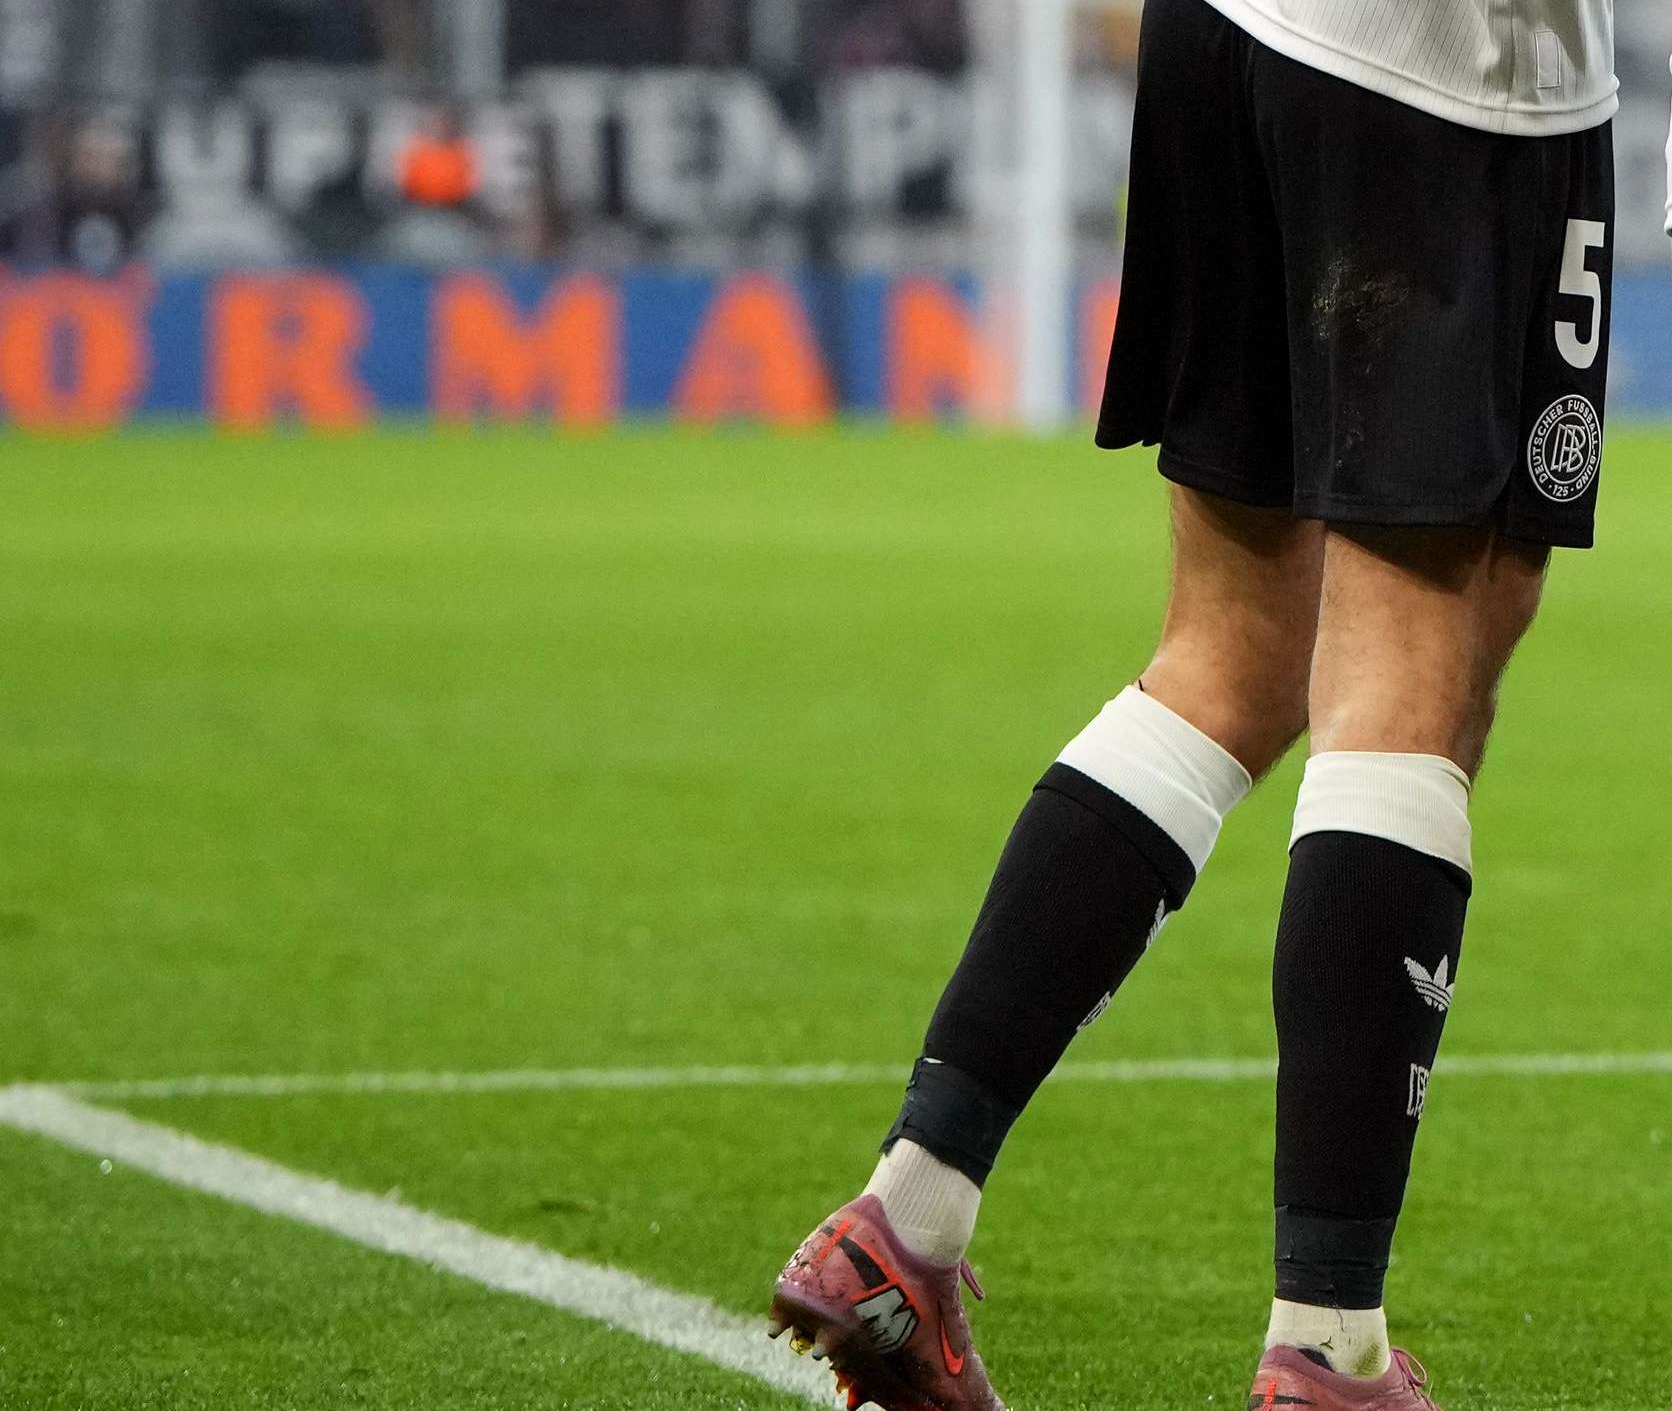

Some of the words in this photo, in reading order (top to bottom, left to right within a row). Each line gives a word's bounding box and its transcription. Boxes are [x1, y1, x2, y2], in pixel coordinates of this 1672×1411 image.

[1554, 218, 1606, 369] 5
[1532, 403, 1565, 485] DEUTSCHER
[1551, 485, 1570, 498] 125
